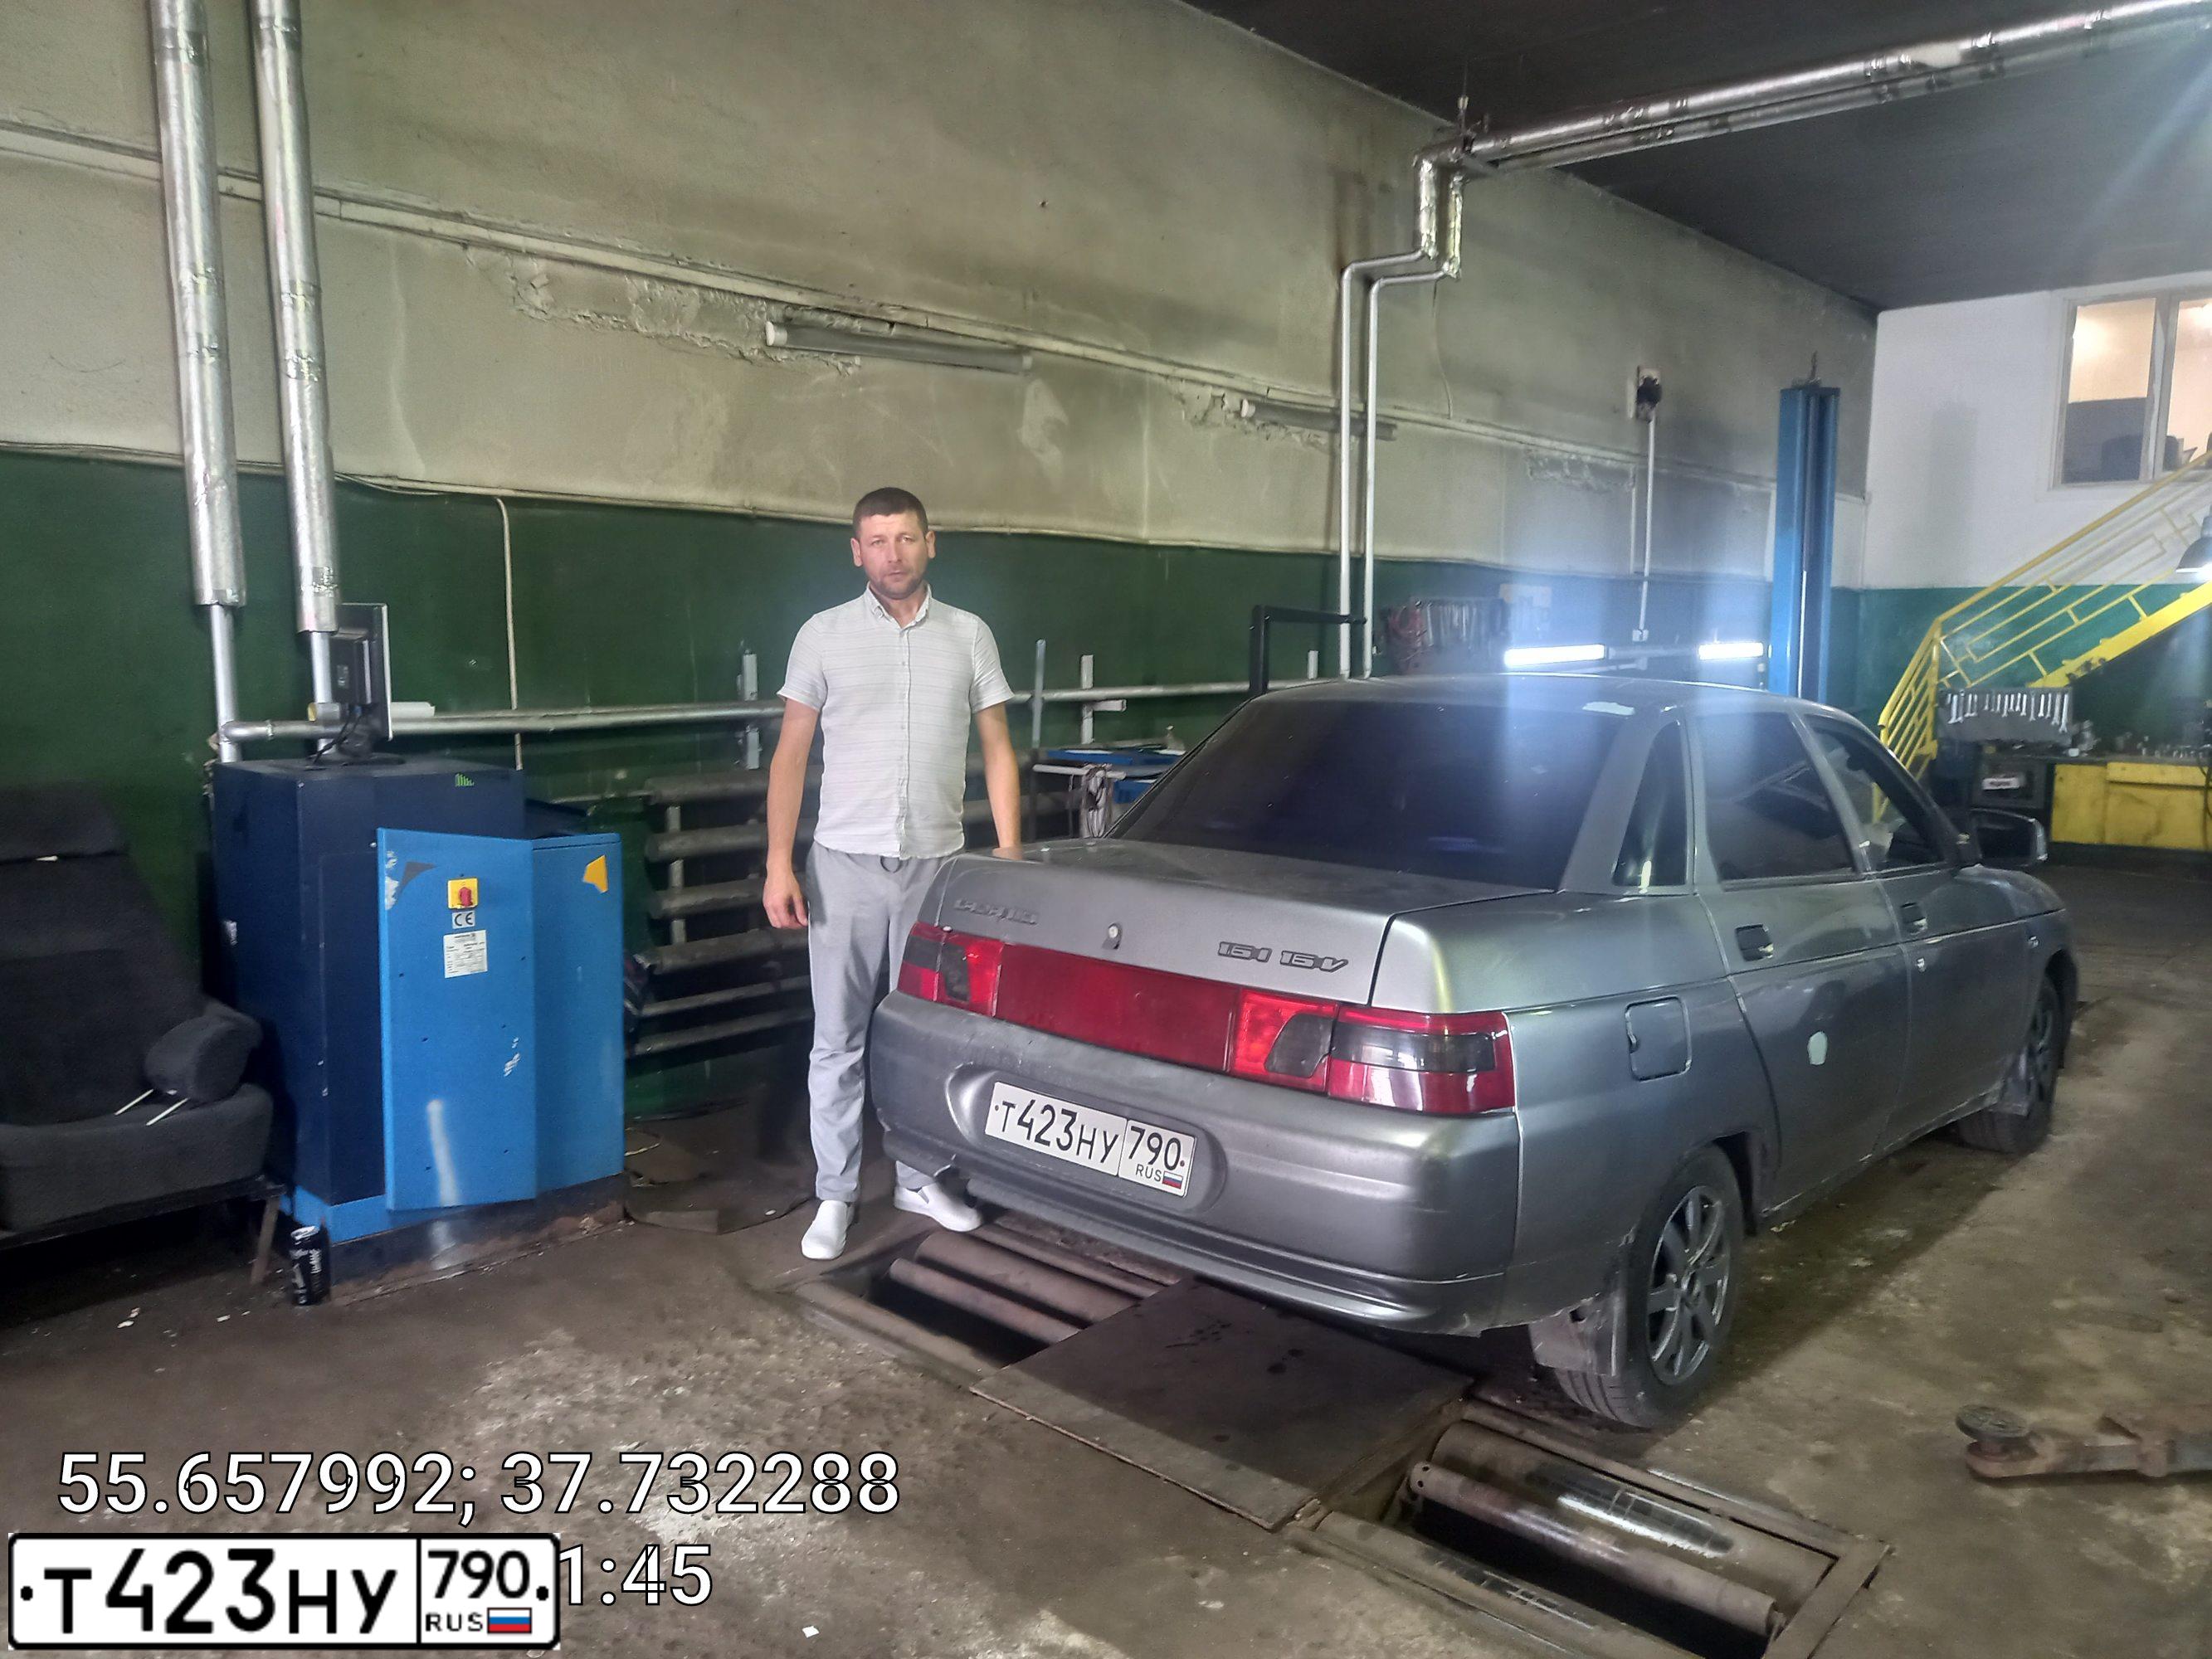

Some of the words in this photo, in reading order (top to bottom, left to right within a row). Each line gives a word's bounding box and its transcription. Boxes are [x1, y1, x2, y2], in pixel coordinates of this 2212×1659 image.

[454, 912, 474, 927] CE
[1128, 1126, 1182, 1171] 790
[1134, 1164, 1162, 1183] RUS
